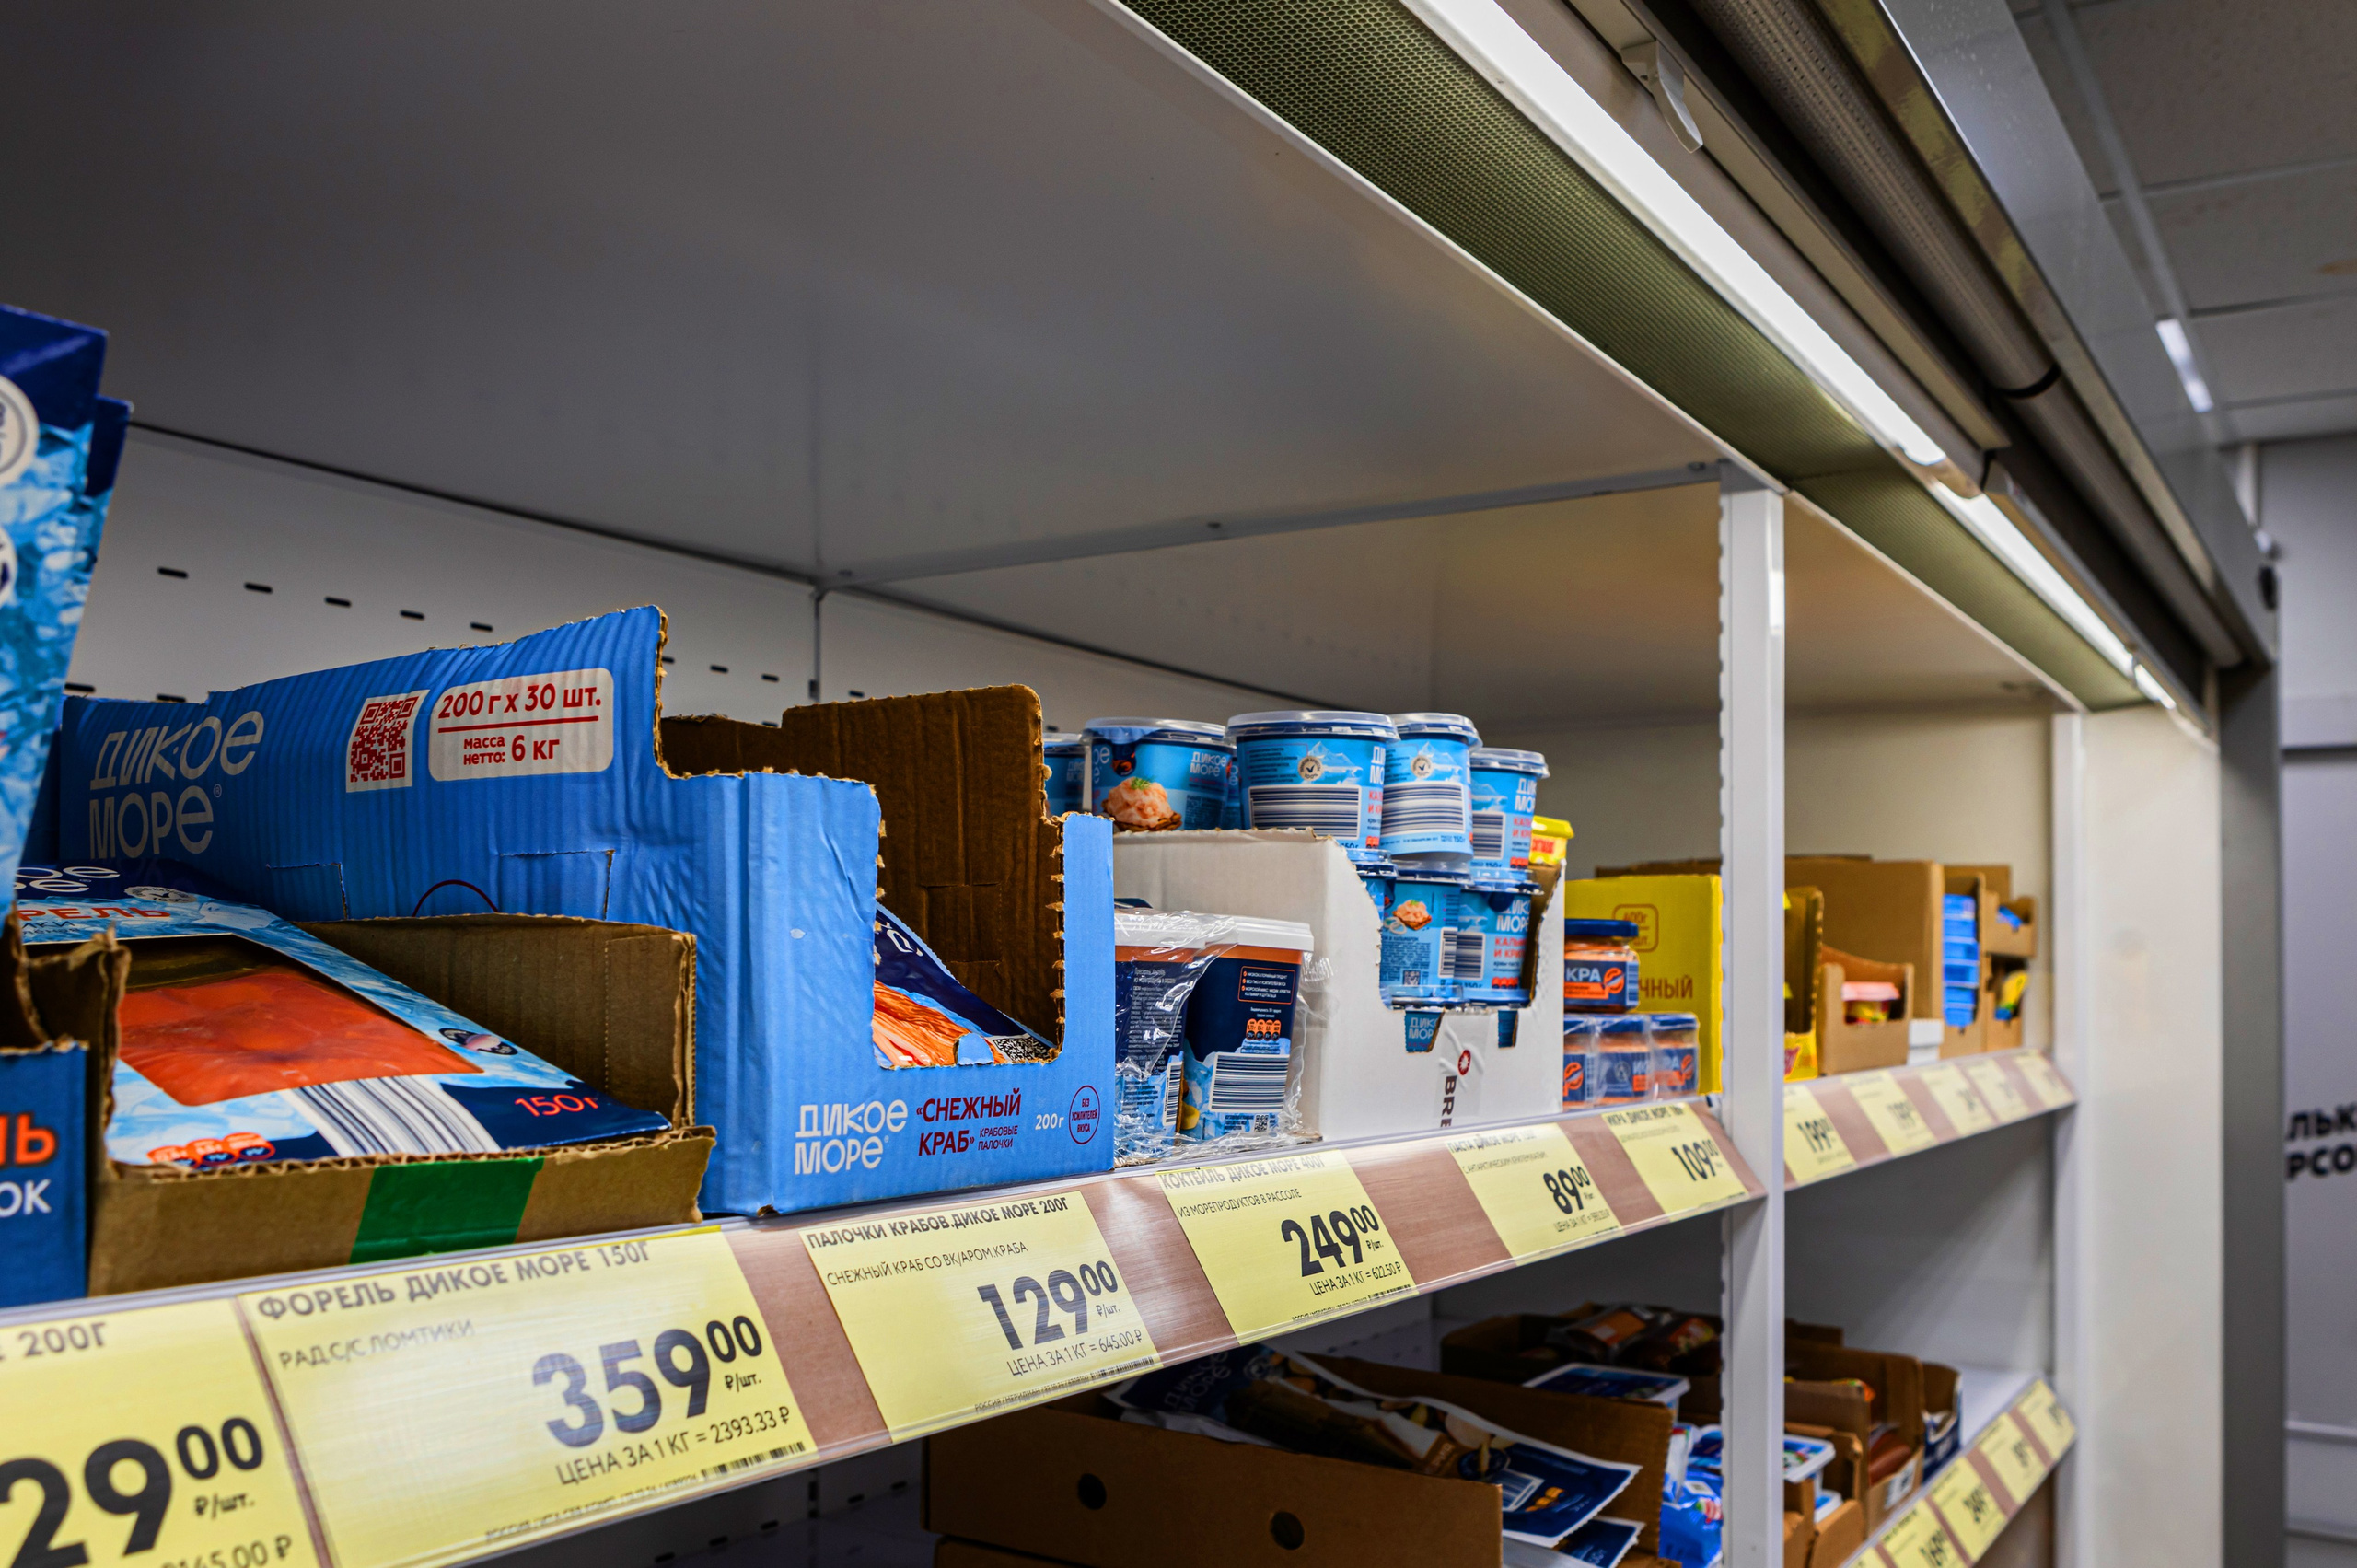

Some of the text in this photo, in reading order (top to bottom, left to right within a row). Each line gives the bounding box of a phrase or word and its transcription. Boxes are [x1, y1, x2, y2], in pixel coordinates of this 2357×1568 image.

[438, 690, 484, 719] 200
[525, 683, 556, 711] 30
[563, 687, 601, 708] шт.
[463, 736, 505, 749] масса
[463, 752, 505, 765] нетто:
[511, 735, 560, 762] 6 кг
[515, 1094, 598, 1117] 150г
[916, 1088, 1022, 1123] «СНЕЖНЫЙ
[918, 1129, 975, 1156] КРАБ»
[978, 1139, 1014, 1151] ПАЛОЧКИ
[979, 1125, 1018, 1138] КРАБОВЫЕ
[1225, 1163, 1269, 1182] ДИКОЕ
[1270, 1157, 1301, 1174] МОРЕ
[1178, 1206, 1191, 1218] ИЗ
[1190, 1195, 1261, 1215] МОРЕПРОДУКТОВ
[1267, 1188, 1302, 1202] РАССОЛЕ
[1543, 1169, 1584, 1214] 89
[807, 1224, 888, 1249] ПАЛОЧКИ
[1001, 1202, 1039, 1220] МОРЕ
[1281, 1204, 1379, 1277] 249 00
[259, 1282, 396, 1319] ФОРЕЛЬ
[406, 1263, 508, 1302] ДИКОЕ
[515, 1251, 591, 1281] МОРЕ
[827, 1261, 893, 1285] СНЕЖНЫЙ
[893, 1258, 923, 1274] КРАБ
[924, 1255, 942, 1269] СО
[1309, 1278, 1337, 1296] ЦЕНА
[1336, 1275, 1351, 1289] ЗА
[1353, 1270, 1365, 1284] КГ
[977, 1260, 1119, 1351] 129 00
[18, 1322, 106, 1358] 200Г
[369, 1319, 476, 1353] ЛОМТИКИ
[1006, 1353, 1048, 1376] ЦЕНА
[1046, 1349, 1066, 1365] ЗА
[1072, 1342, 1086, 1359] КГ
[1098, 1331, 1135, 1353] 645.00
[531, 1315, 763, 1448] 359 00
[176, 1417, 263, 1482] 00
[555, 1452, 623, 1486] ЦЕНА
[622, 1444, 655, 1467] ЗА
[655, 1439, 665, 1458] 1
[667, 1431, 690, 1457] КГ
[710, 1410, 778, 1444] 2393.33
